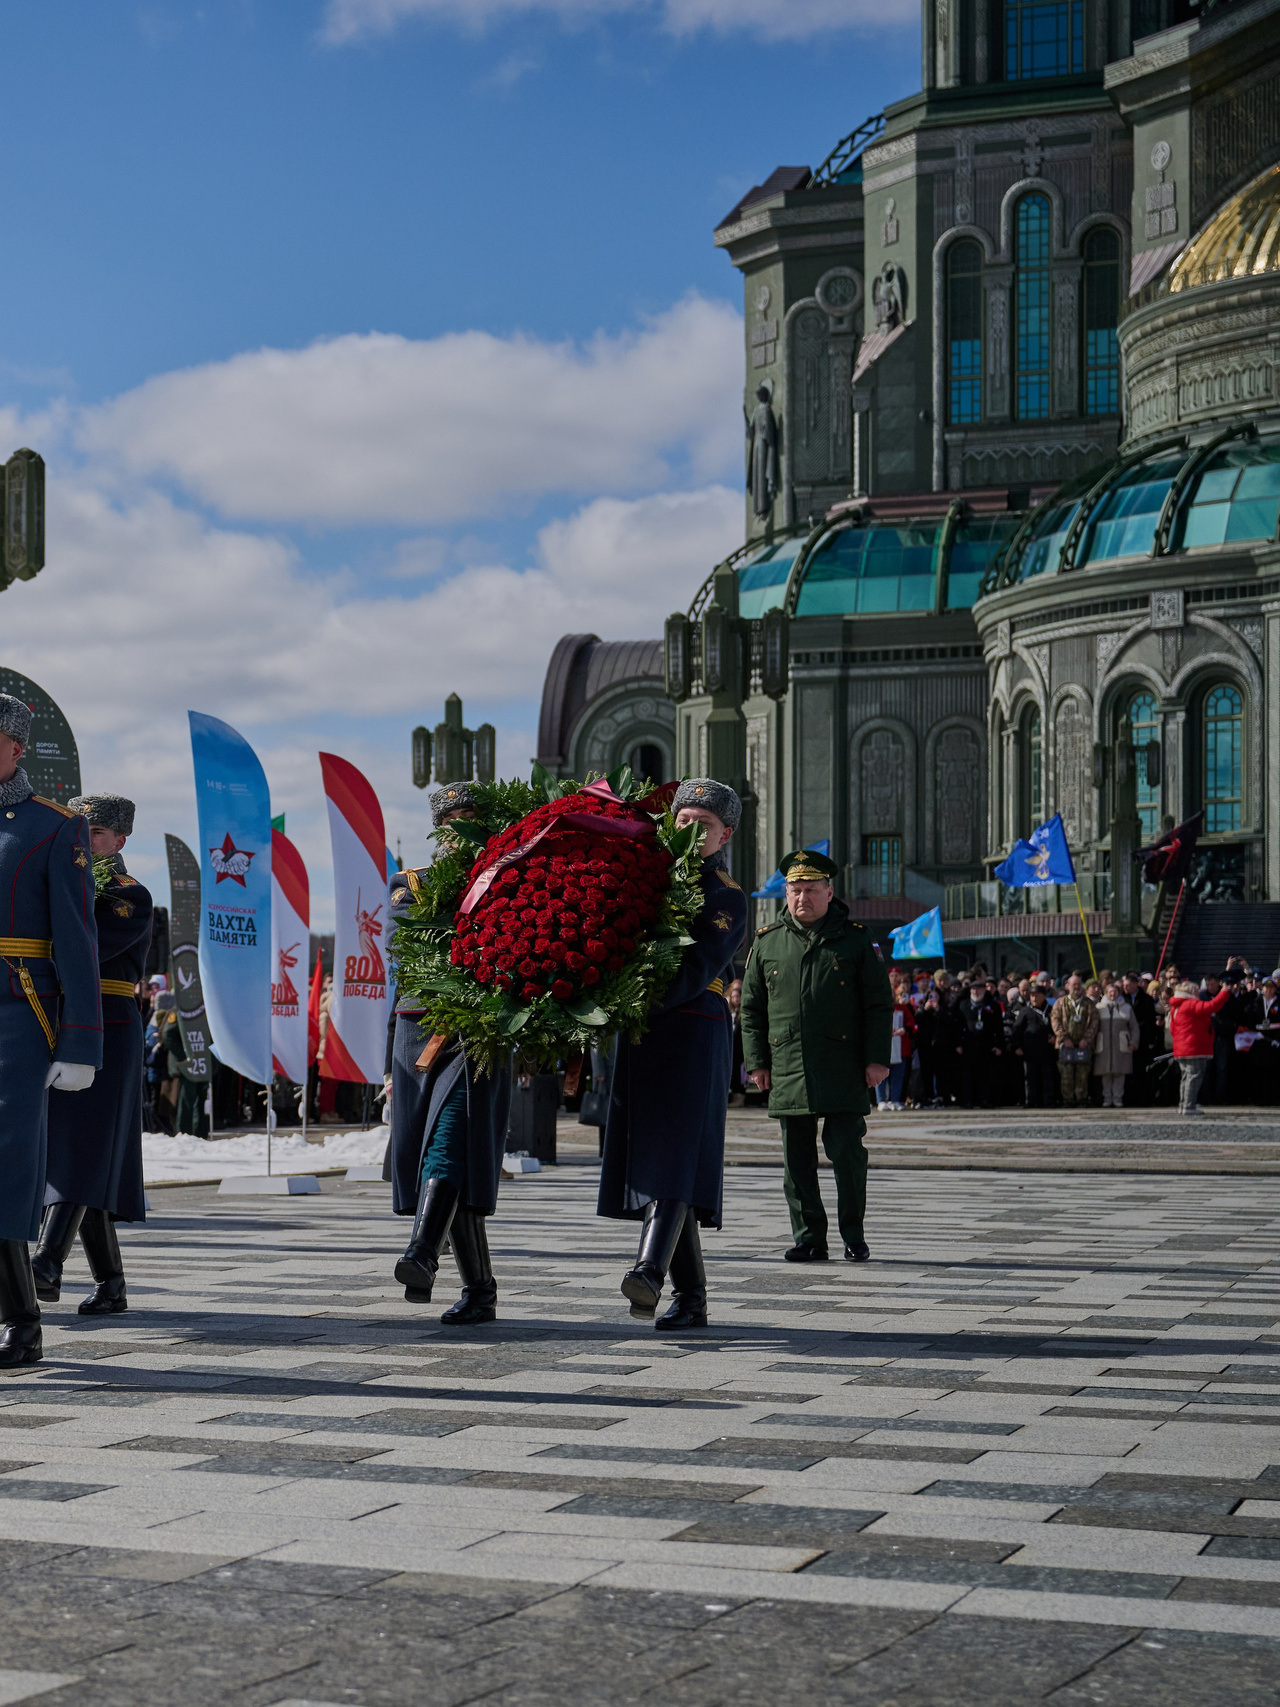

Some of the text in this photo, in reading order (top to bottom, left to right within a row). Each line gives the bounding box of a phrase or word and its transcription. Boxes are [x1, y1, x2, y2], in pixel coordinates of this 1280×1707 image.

[208, 911, 257, 932] ВАХТА
[209, 929, 257, 946] ПАМЯТИ
[345, 955, 370, 979] 80
[343, 984, 386, 1001] ПОБЕДА!
[271, 1005, 299, 1017] ОБЕДА!
